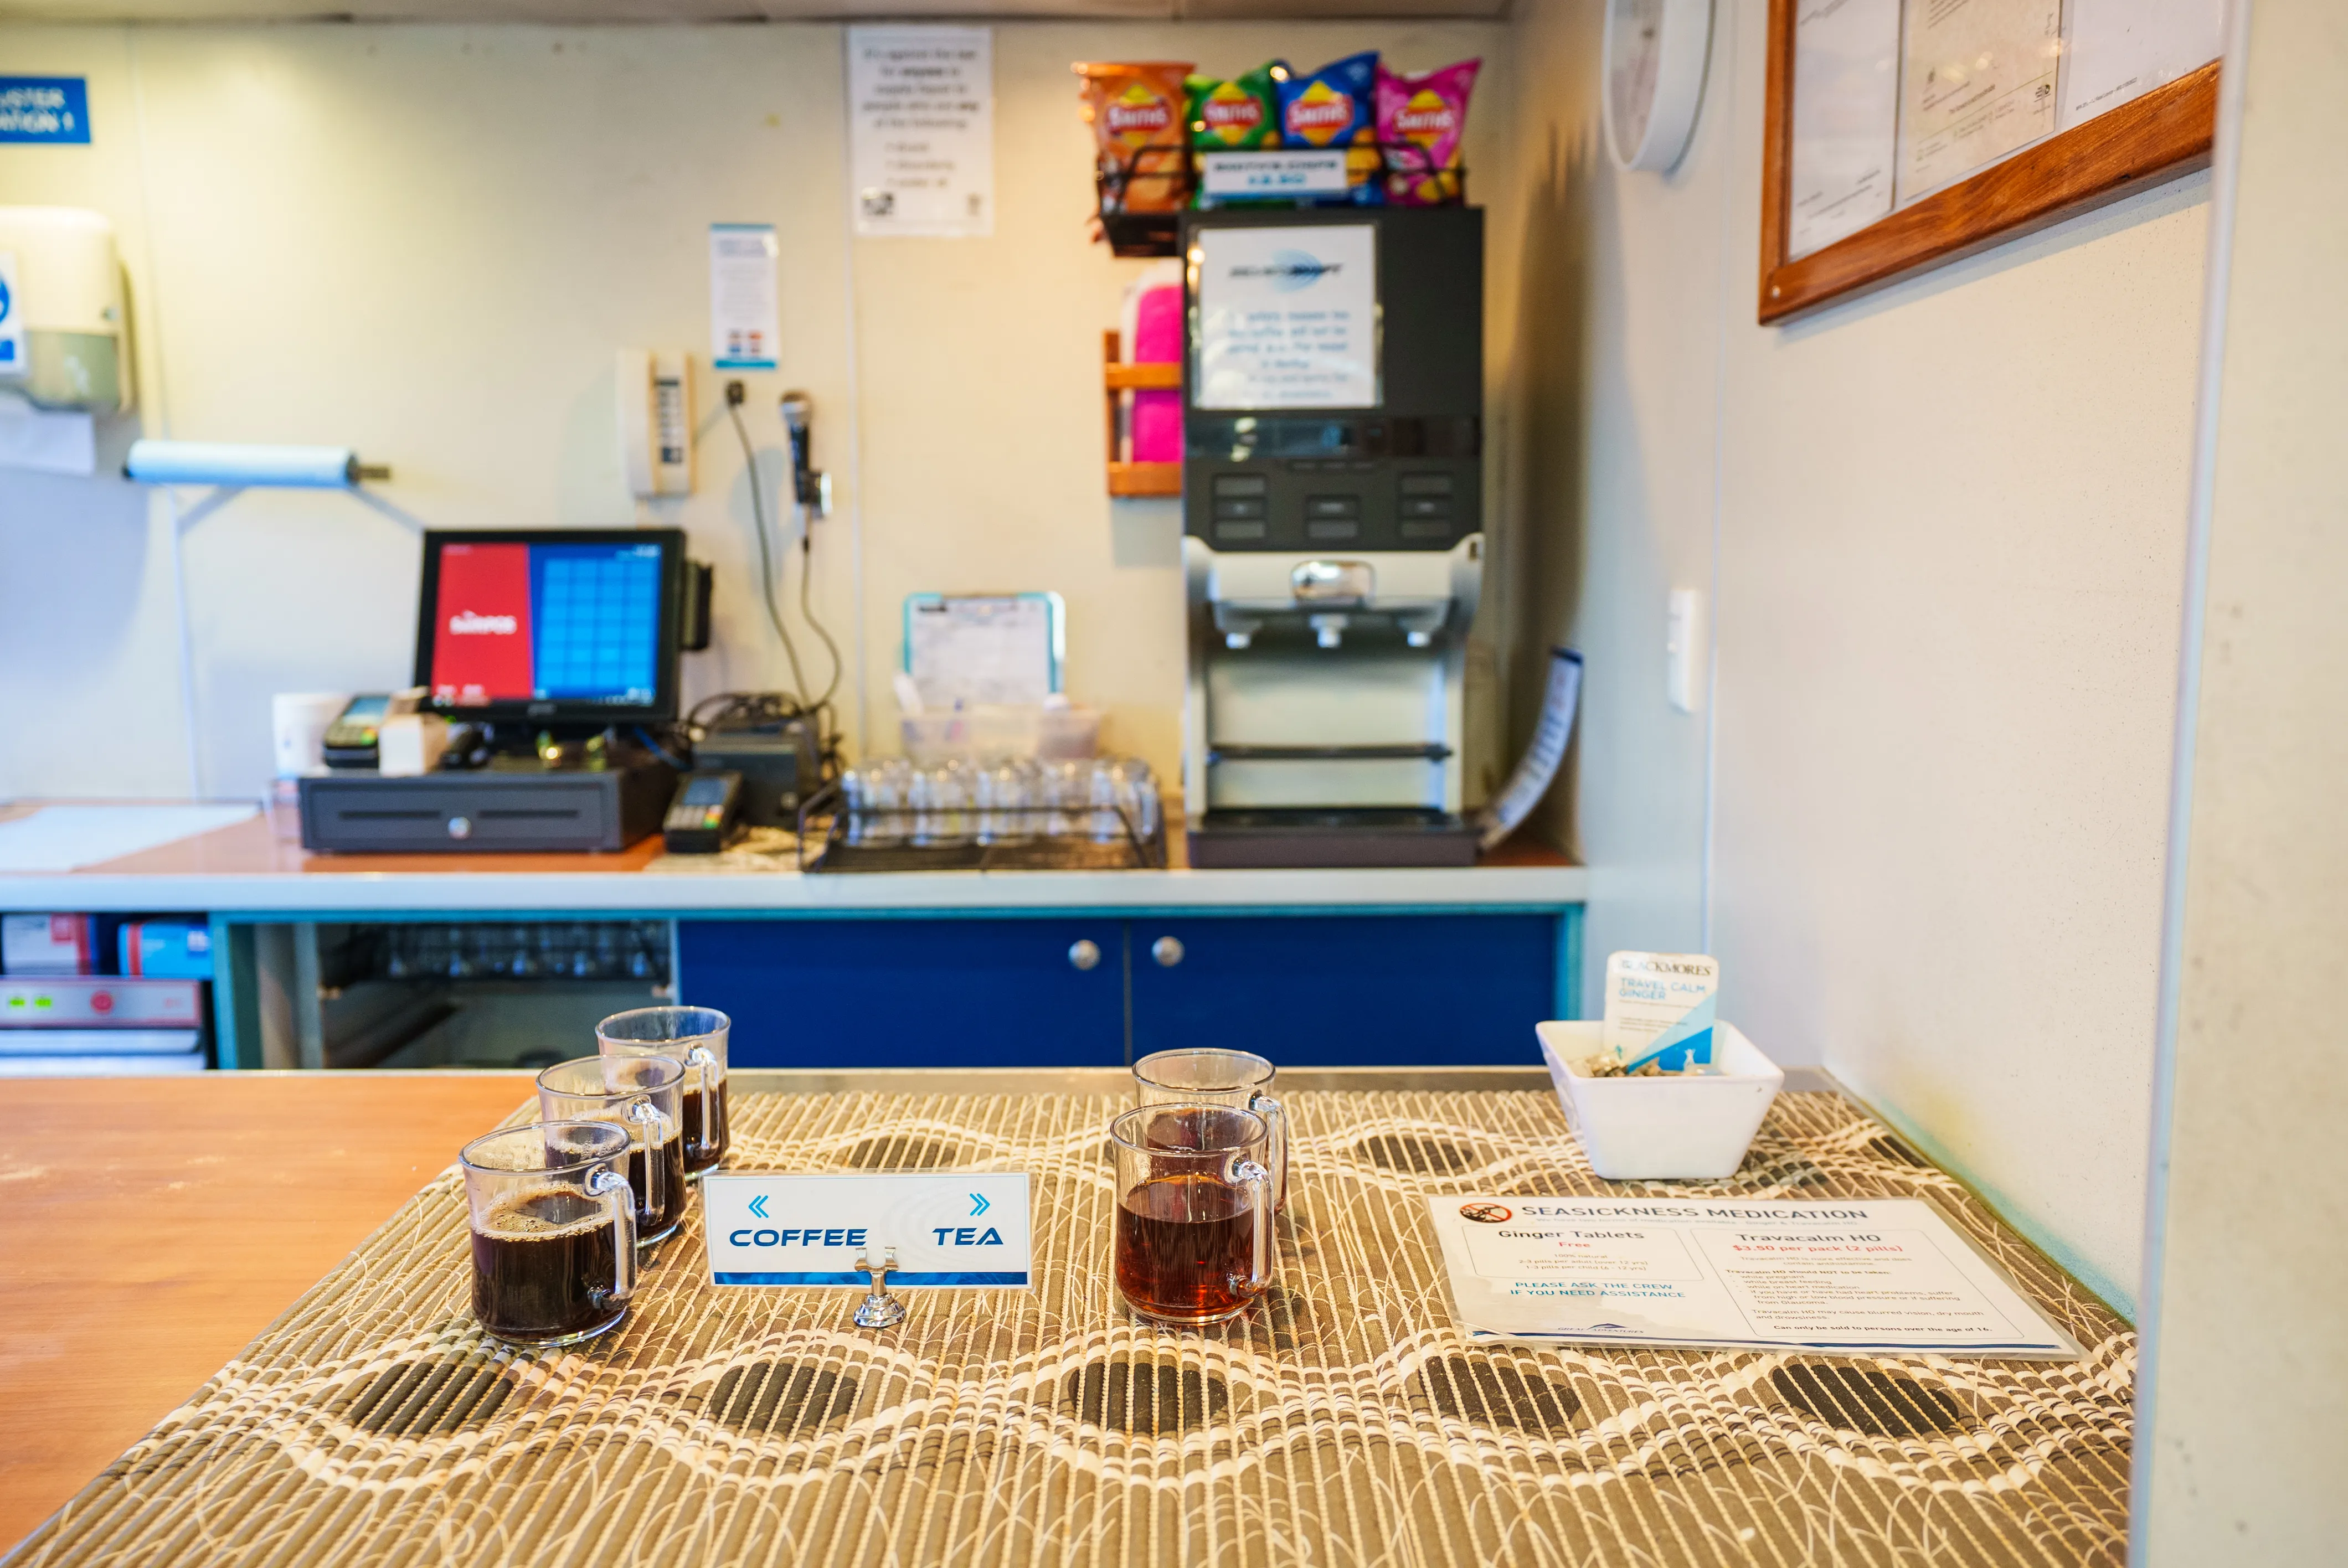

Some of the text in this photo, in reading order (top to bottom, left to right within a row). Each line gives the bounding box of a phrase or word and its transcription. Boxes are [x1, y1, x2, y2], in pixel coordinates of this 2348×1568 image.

[1622, 960, 1712, 976] BACKMORES
[1621, 977, 1706, 993] TRAVEL CALM
[1619, 988, 1666, 999] GINGER
[1521, 1206, 1869, 1219] SEASICKNESS MEDICATION
[729, 1227, 1004, 1247] COFFEE TEA
[1498, 1230, 1564, 1239] Ginger
